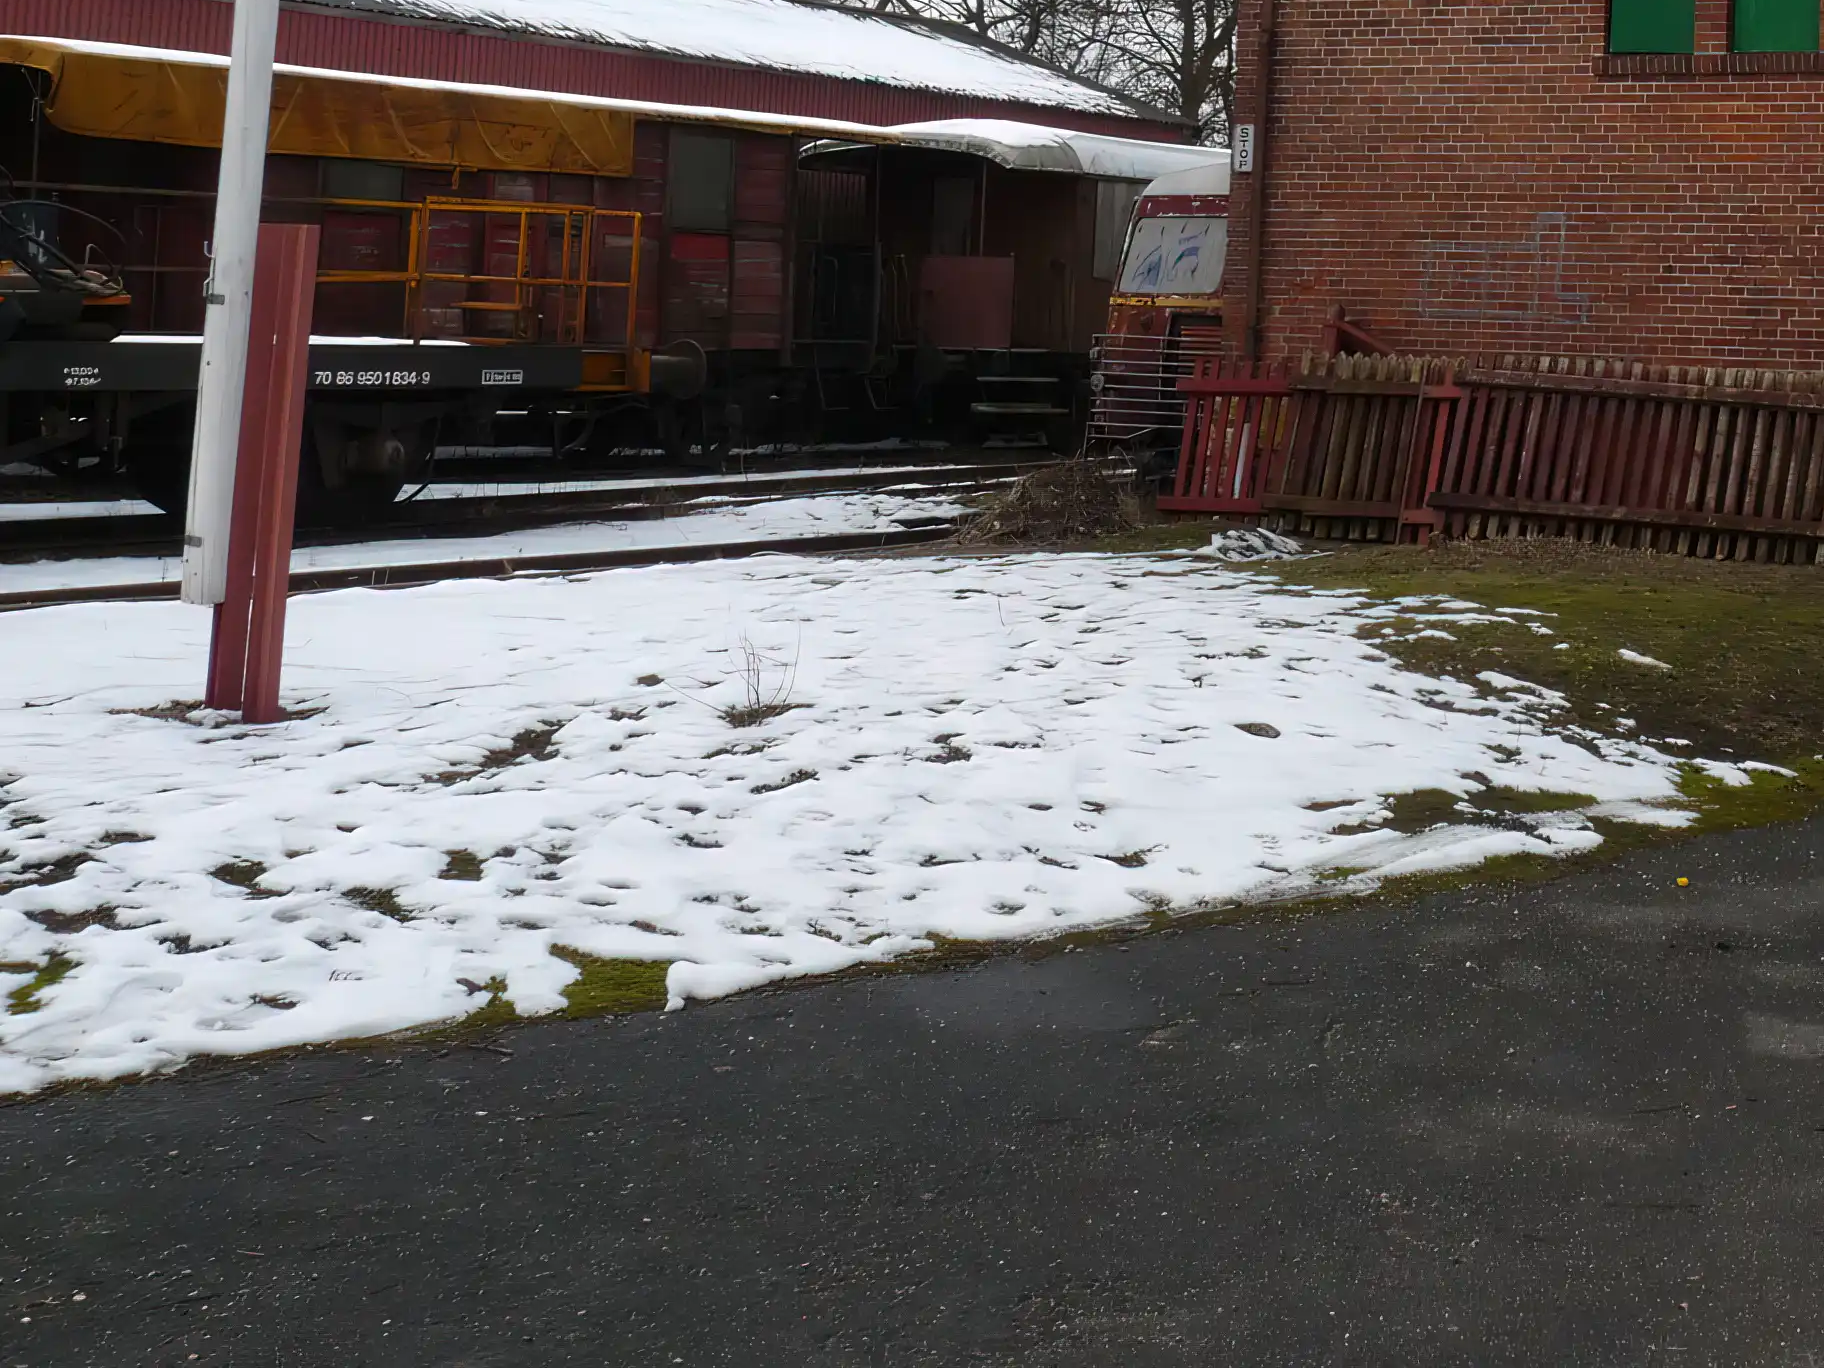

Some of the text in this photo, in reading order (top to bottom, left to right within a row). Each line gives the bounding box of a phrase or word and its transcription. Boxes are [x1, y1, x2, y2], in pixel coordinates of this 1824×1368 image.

[1239, 127, 1249, 169] STOP
[314, 371, 332, 385] 70
[336, 371, 354, 385] 86
